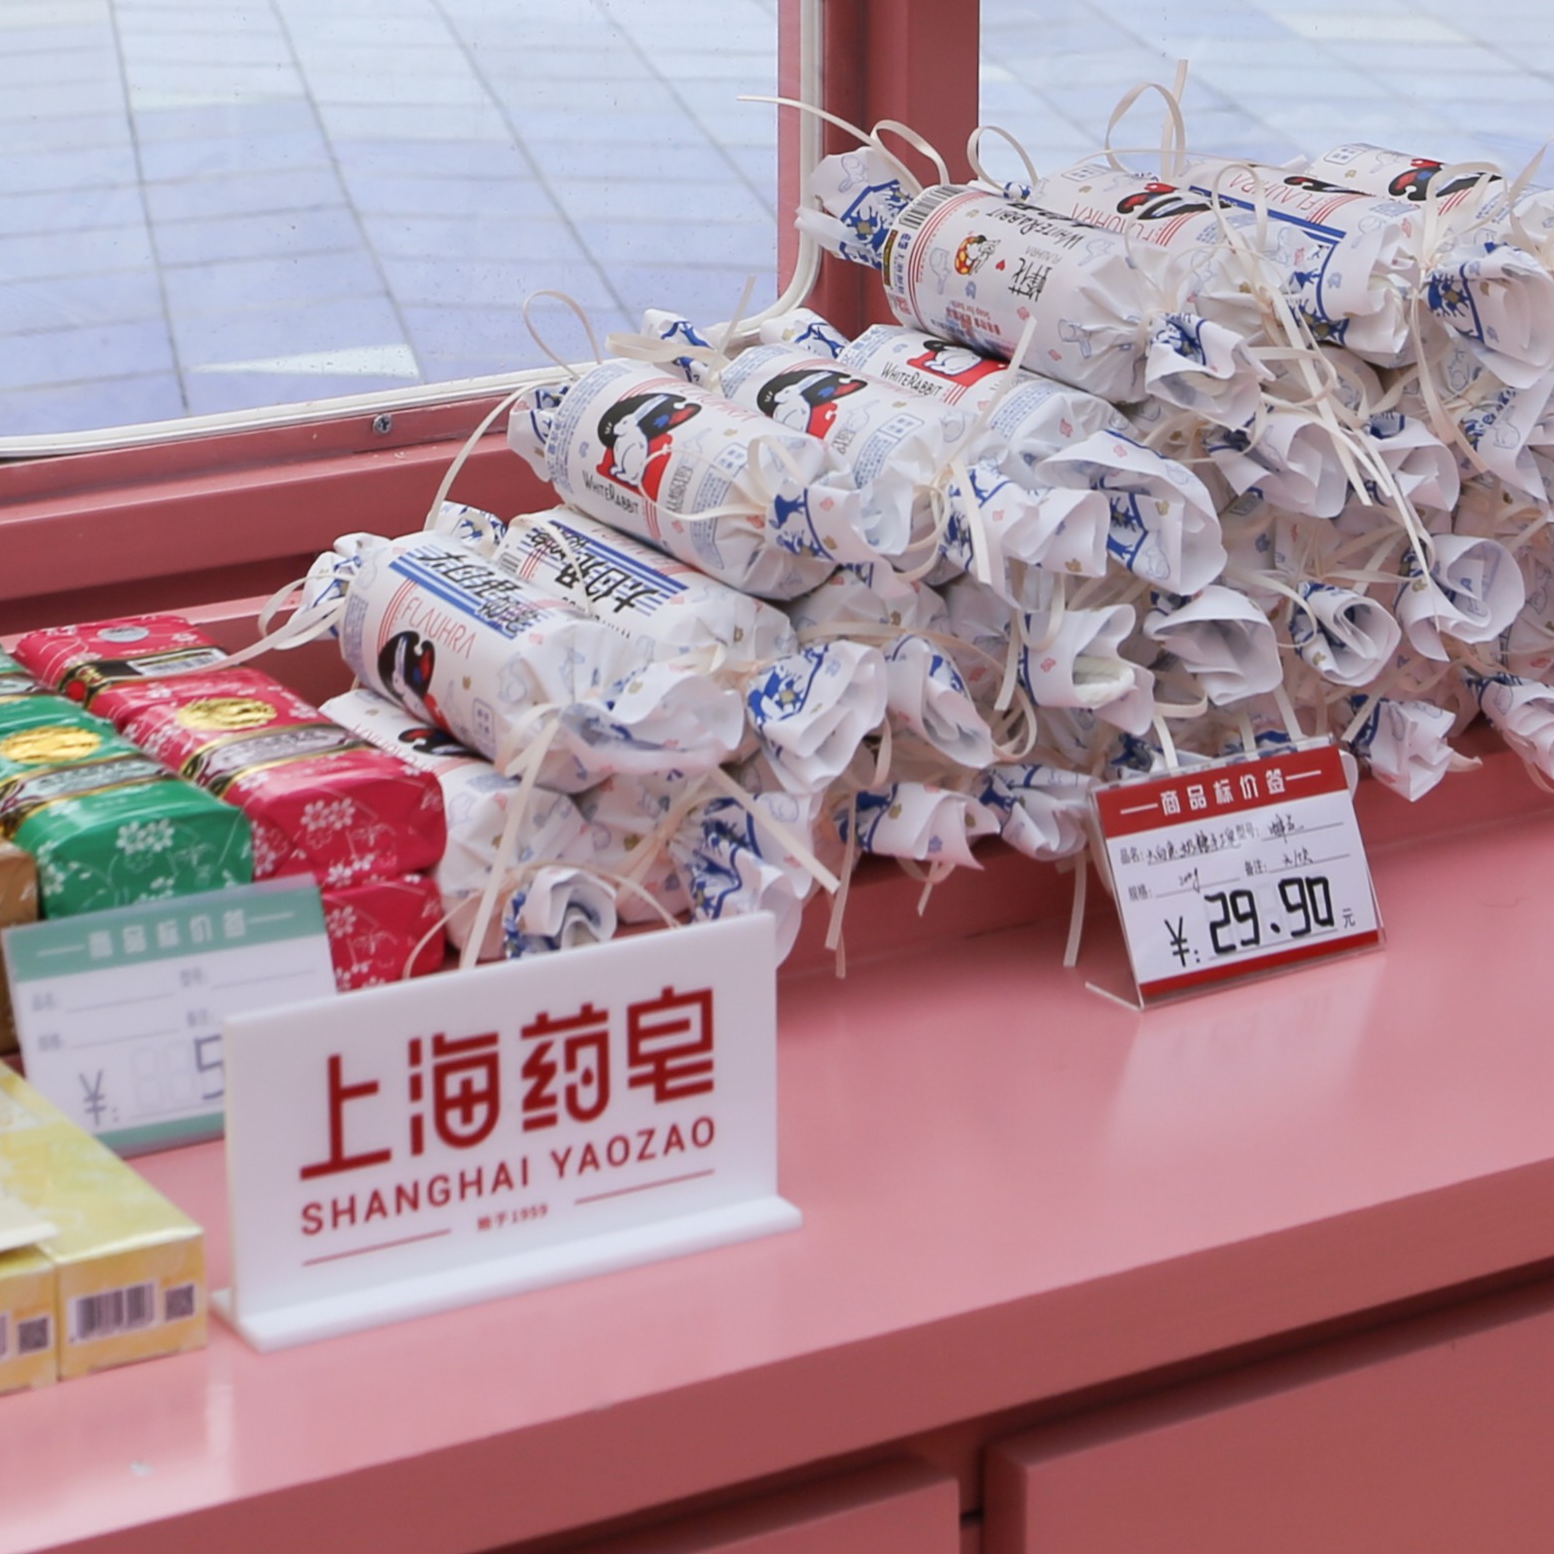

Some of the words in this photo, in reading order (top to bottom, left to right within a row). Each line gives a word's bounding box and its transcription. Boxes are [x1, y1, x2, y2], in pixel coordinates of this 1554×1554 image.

[401, 597, 476, 659] FLAUHRA
[1160, 768, 1286, 817] 商品标价签
[1204, 876, 1334, 955] 29.90
[1342, 908, 1355, 928] 元
[299, 986, 714, 1181] 上海药皂
[301, 1157, 529, 1235] SHANGHAI
[551, 1117, 715, 1180] YAOZAO
